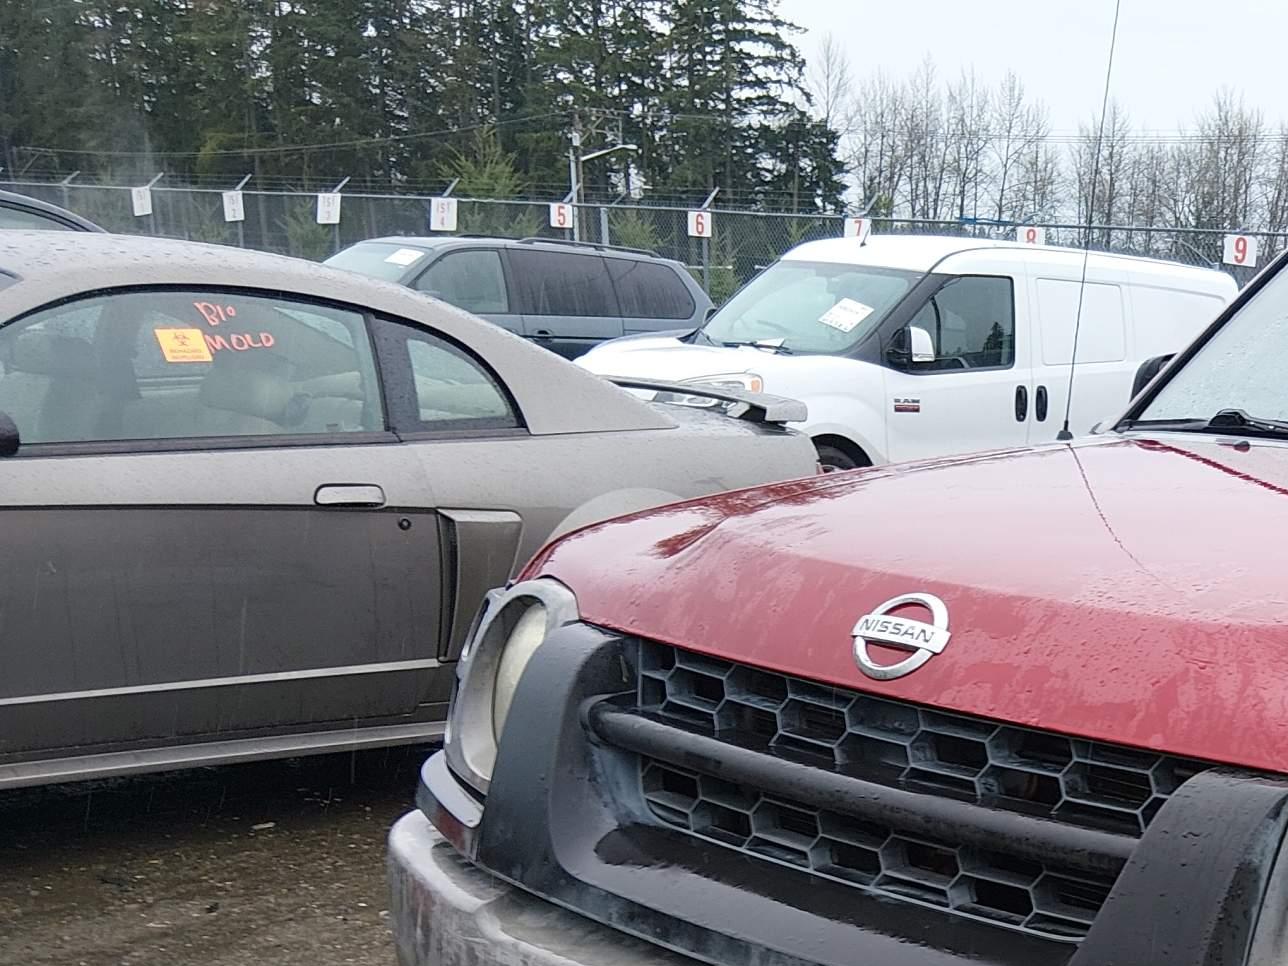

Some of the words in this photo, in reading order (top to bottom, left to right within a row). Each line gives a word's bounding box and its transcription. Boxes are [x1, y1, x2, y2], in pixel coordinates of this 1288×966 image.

[557, 204, 566, 226] 5
[695, 213, 705, 235] 6
[853, 219, 863, 237] 7
[1234, 237, 1248, 264] 9
[205, 332, 275, 354] MOLD
[859, 618, 935, 643] NISSAN
